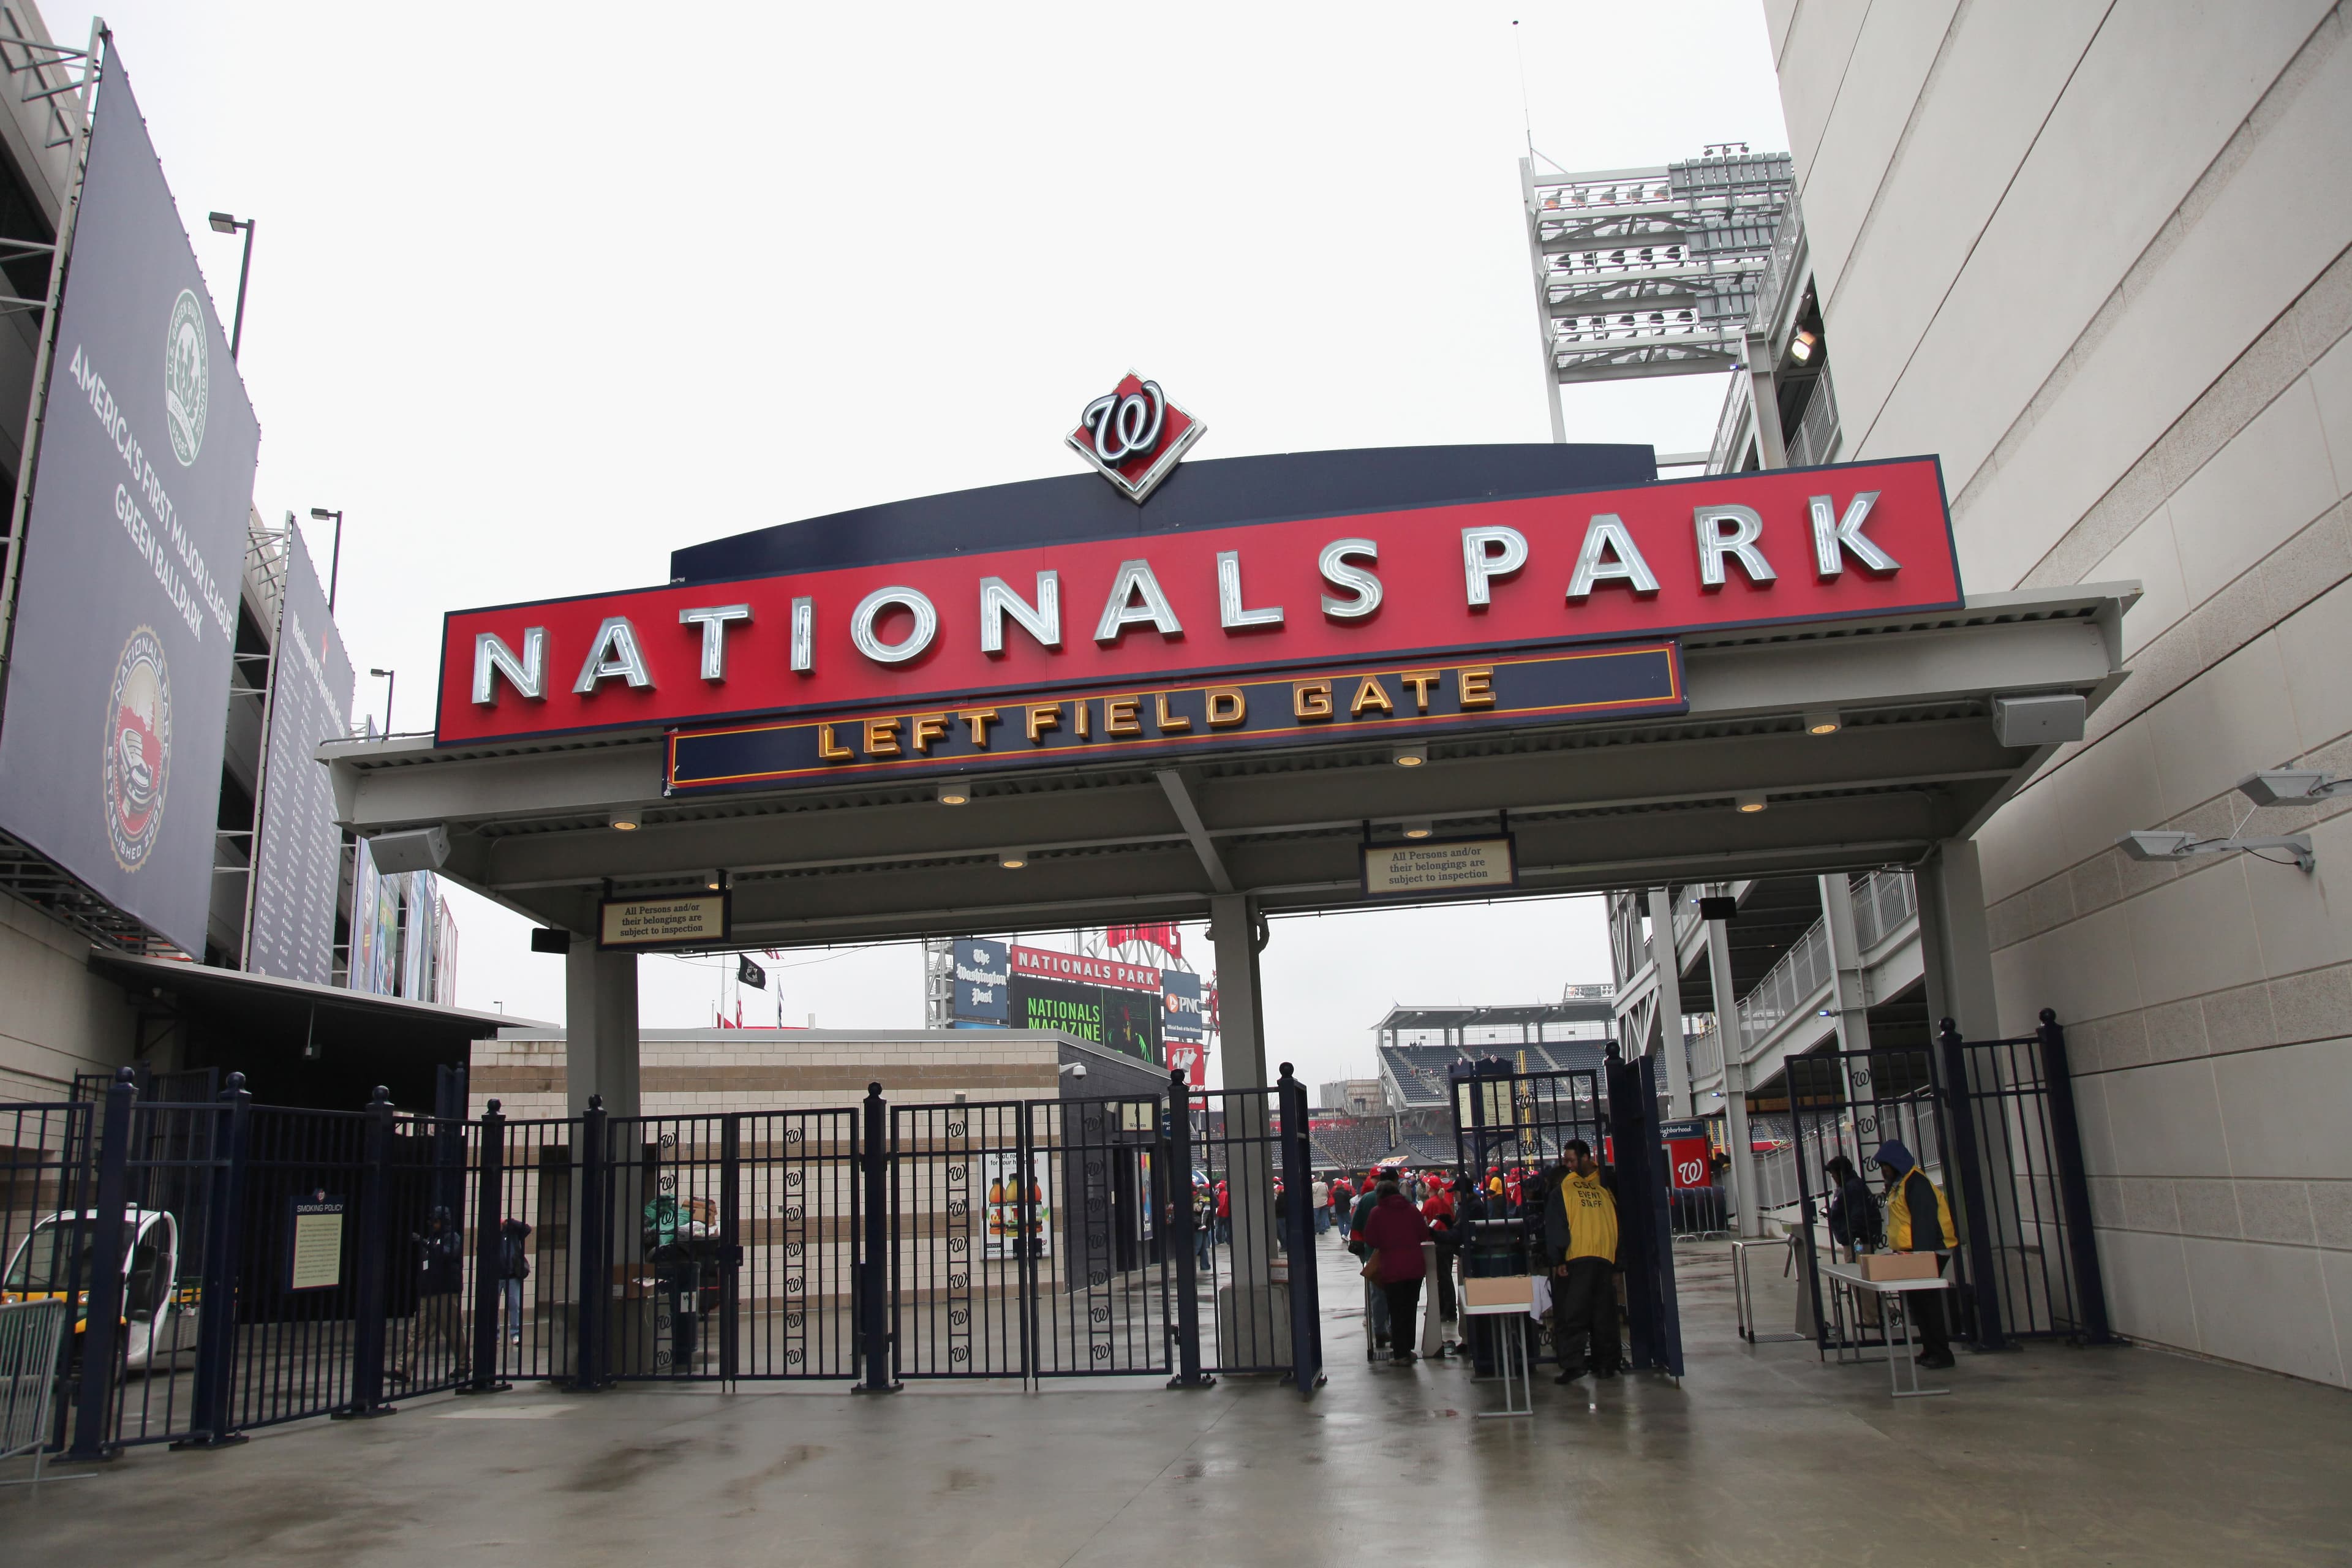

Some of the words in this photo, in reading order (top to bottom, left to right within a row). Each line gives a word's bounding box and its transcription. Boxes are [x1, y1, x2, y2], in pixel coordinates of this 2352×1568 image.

[172, 303, 187, 340] GREEN
[187, 301, 205, 360] BUILDING
[195, 366, 206, 437] COUNCIL
[172, 421, 187, 456] USGBC
[70, 344, 143, 480] AMERICA'S
[143, 461, 173, 531] FIRST
[172, 512, 204, 589] MAJOR
[203, 570, 233, 643] LEAGUE
[115, 483, 156, 567] GREEN
[155, 545, 203, 643] BALLPARK
[472, 537, 1383, 709] NATIONALS
[1461, 490, 1903, 611] PARK
[115, 637, 164, 701] NATIONALS
[818, 709, 998, 762] LEFT
[1026, 687, 1246, 742] FIELD
[1292, 666, 1496, 721] GATE
[107, 745, 142, 860] ESTABLISHED
[145, 794, 163, 850] 2008
[1392, 852, 1406, 861] All
[1409, 850, 1447, 860] Persons
[1450, 848, 1482, 857] and/or
[1390, 864, 1412, 873] their
[1415, 859, 1467, 871] belongings
[1389, 874, 1423, 885] subject
[1439, 870, 1488, 882] inspection
[625, 906, 636, 915] All
[639, 905, 671, 914] Persons
[674, 903, 700, 912] and/or
[620, 927, 648, 937] subject
[662, 924, 703, 935] inspection
[643, 915, 687, 925] belongings
[973, 949, 990, 965] The
[956, 962, 1006, 987] Washington
[1018, 952, 1111, 979] NATIONALS
[1117, 968, 1155, 986] PARK
[972, 988, 993, 1006] Post
[1177, 997, 1202, 1014] PNC
[1028, 997, 1100, 1022] NATIONALS
[1028, 1017, 1101, 1041] MAGAZINE
[1660, 1125, 1692, 1137] ighborhood
[1573, 1181, 1596, 1189] CSC
[1577, 1190, 1600, 1199] EVENT
[296, 1204, 323, 1213] SMOKING
[1581, 1199, 1602, 1208] STAFF
